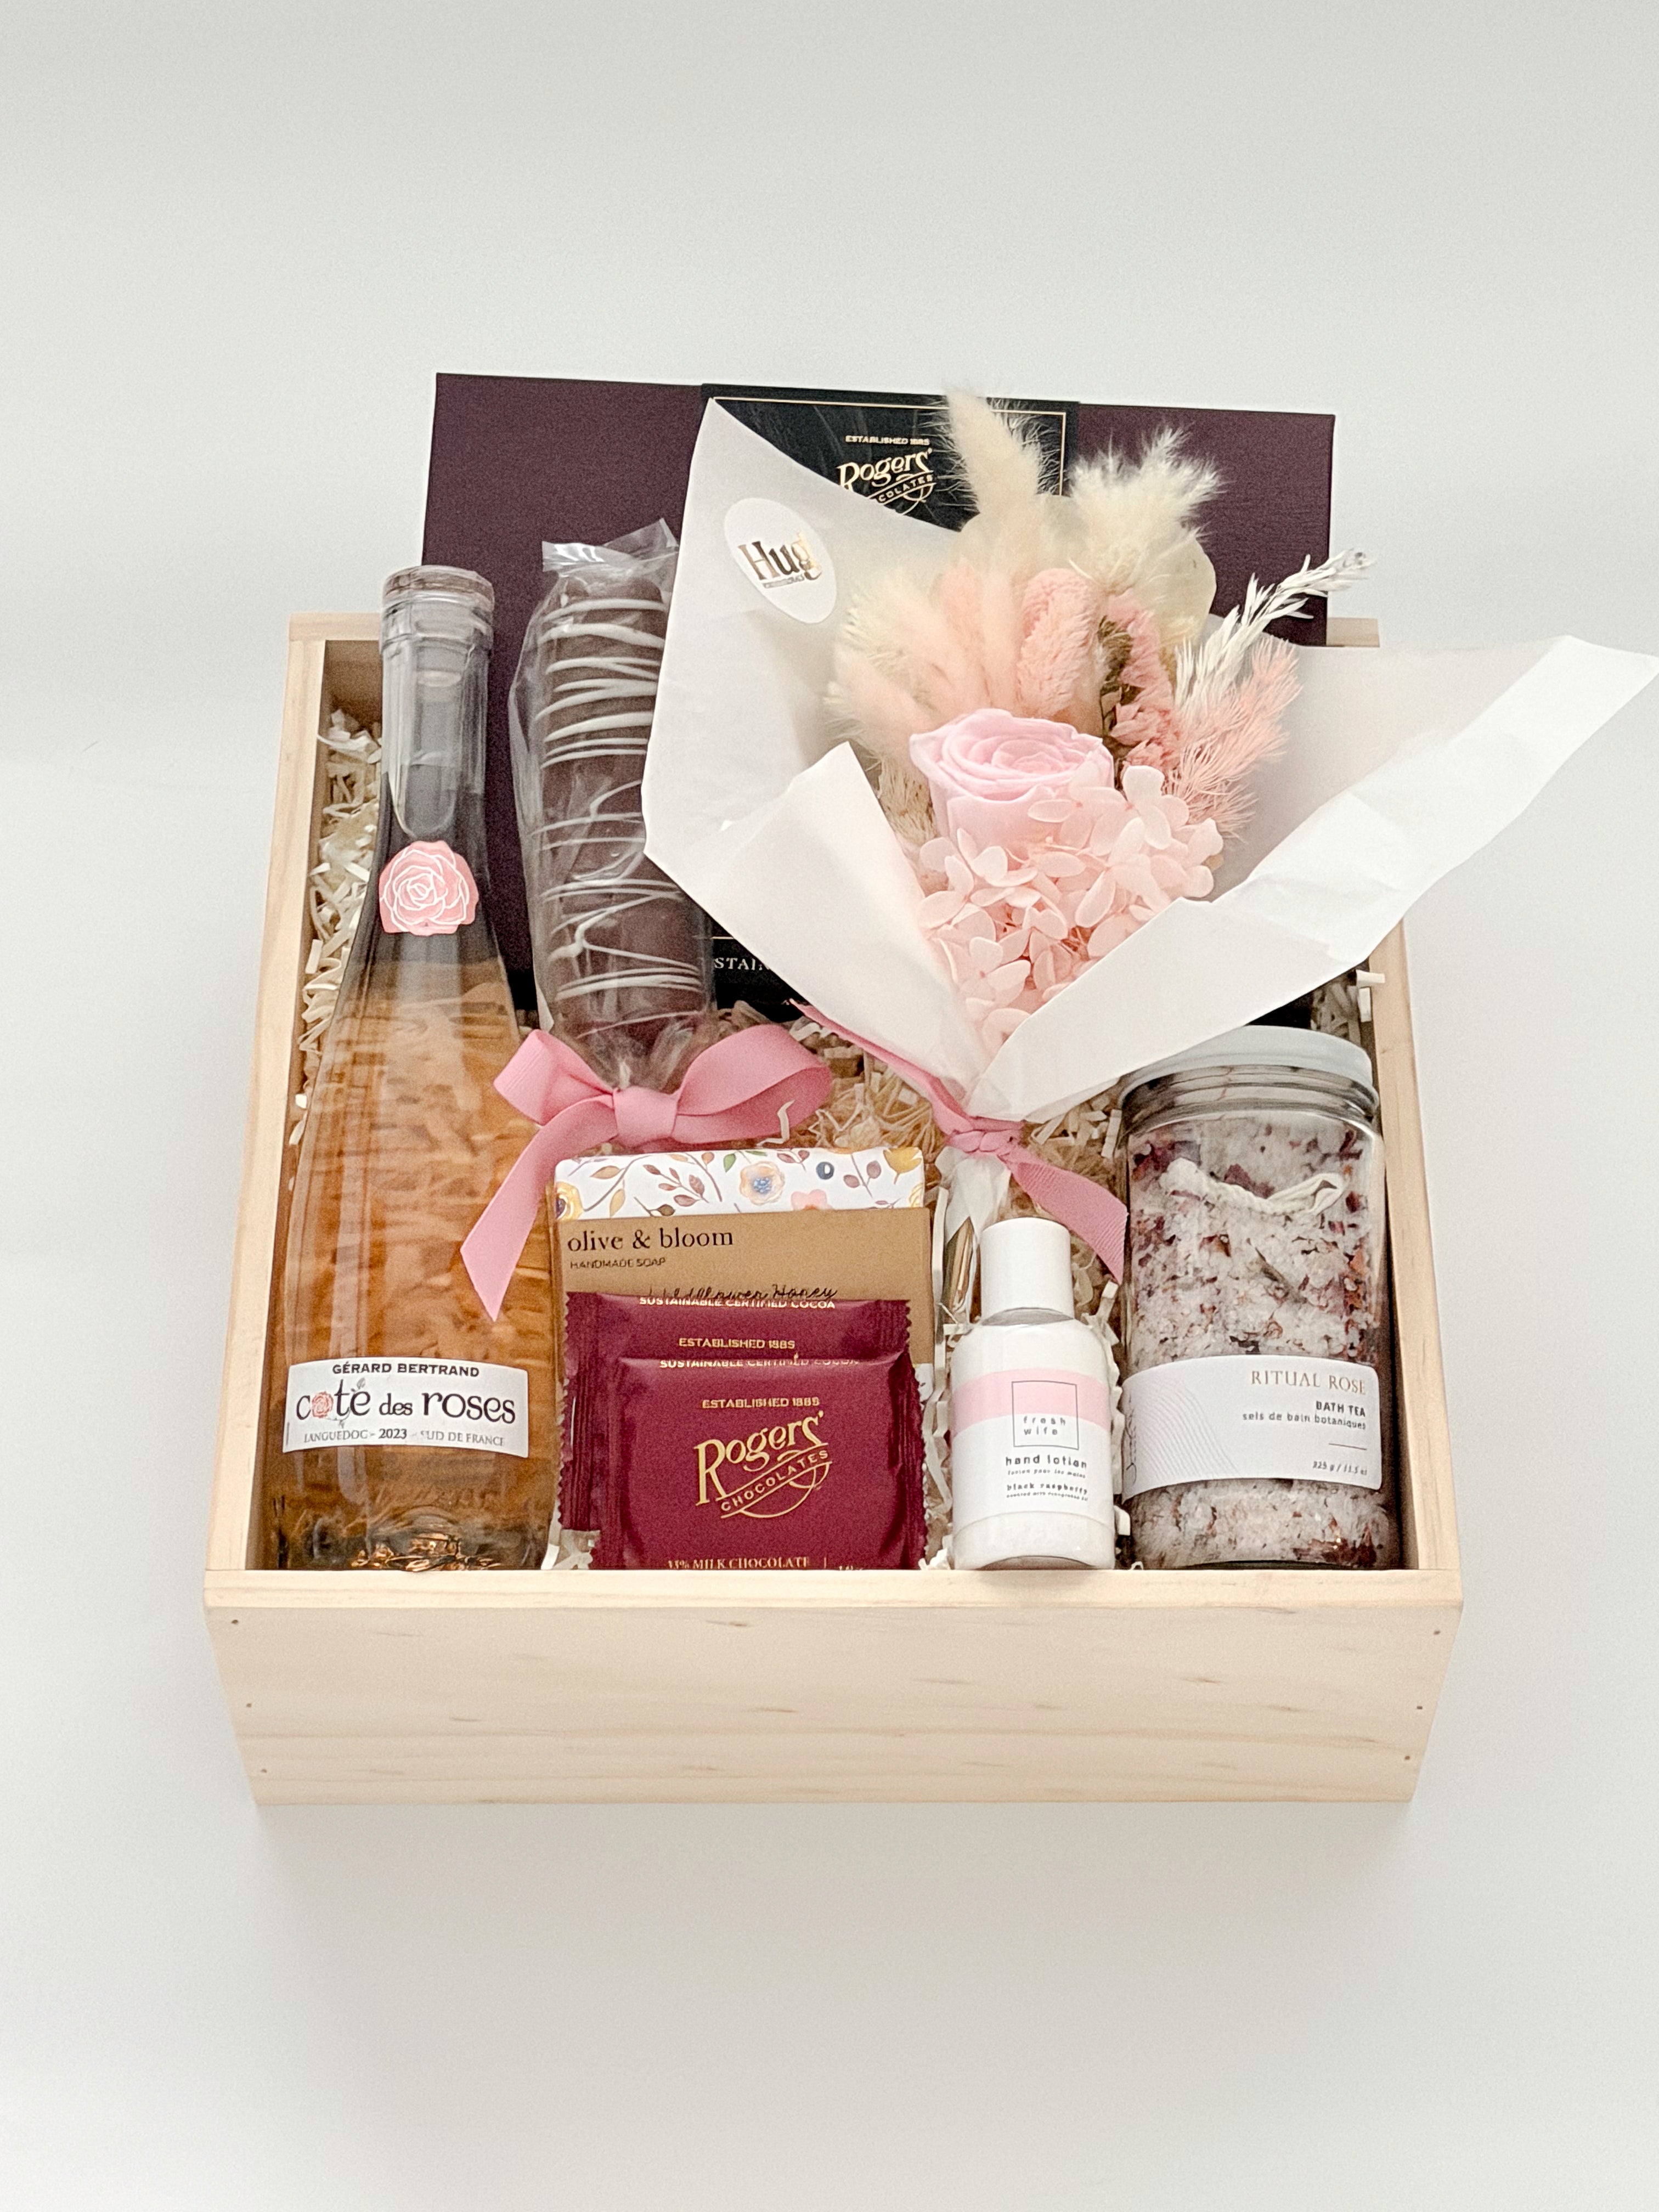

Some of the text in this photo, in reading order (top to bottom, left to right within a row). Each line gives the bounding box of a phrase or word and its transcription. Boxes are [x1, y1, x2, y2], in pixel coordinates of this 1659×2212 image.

[845, 435, 908, 444] ESTABLISHED
[738, 532, 822, 580] Hug
[568, 1227, 733, 1251] olive & bloom
[570, 1257, 666, 1269] HANDMADE SOAP
[772, 1284, 838, 1301] Honey
[791, 1300, 835, 1309] COCOA
[679, 1338, 795, 1350] ESTABLISHED 1885
[332, 1361, 479, 1378] GÉRARD BERTRAND
[1251, 1370, 1366, 1396] RITUAL ROSE
[379, 1392, 413, 1416] des
[421, 1392, 516, 1424] roses
[702, 1398, 789, 1409] ESTABLISHED
[1316, 1400, 1366, 1418] BATH TEA
[1243, 1411, 1366, 1430] sels de bain botaniques
[379, 1428, 408, 1440] 2023
[1024, 1425, 1058, 1436] wife
[1006, 1454, 1087, 1469] hand lotion
[720, 1449, 829, 1511] CHOCOLATES
[1007, 1482, 1035, 1491] black
[693, 1558, 725, 1570] MILK
[729, 1556, 810, 1569] CHOCOLATE
